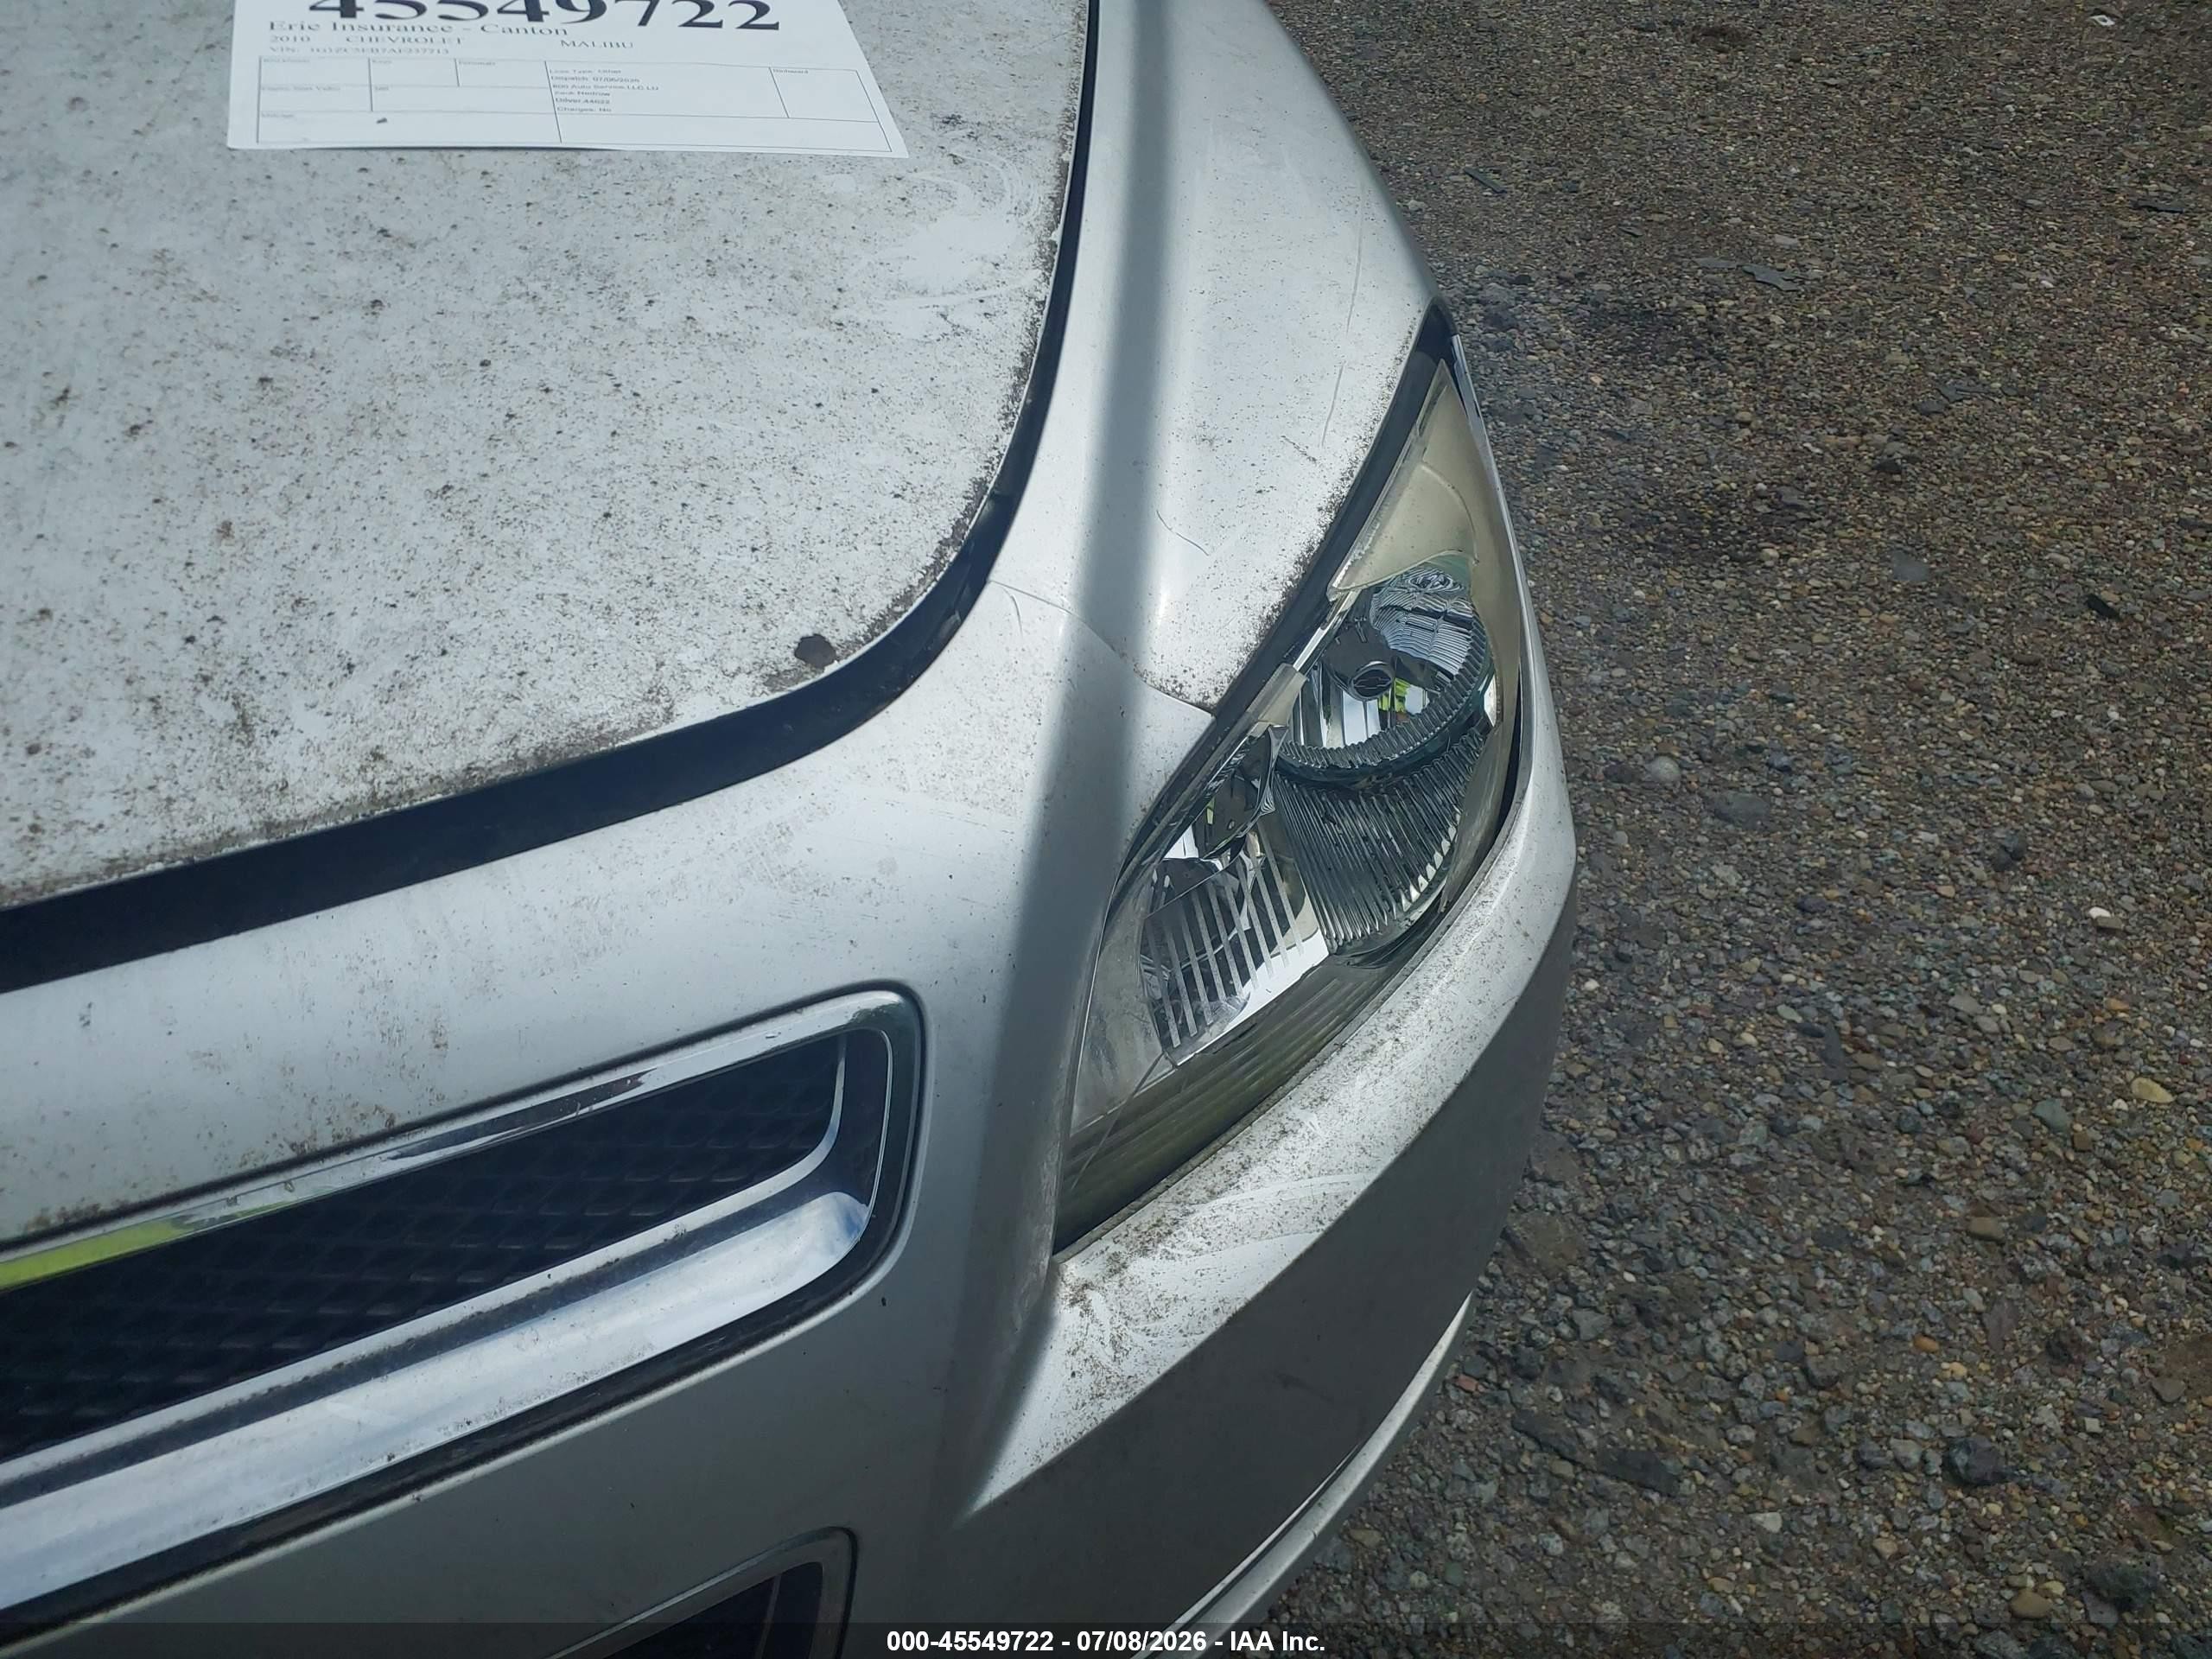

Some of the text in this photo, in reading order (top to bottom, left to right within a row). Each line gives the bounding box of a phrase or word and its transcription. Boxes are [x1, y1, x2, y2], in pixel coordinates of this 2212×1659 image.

[308, 0, 780, 30] 45549722
[270, 21, 321, 31] Erie
[332, 21, 454, 33] Insurance
[480, 22, 569, 35] Canton
[346, 35, 465, 45] CHEVROLET
[560, 40, 634, 48] MALIBU
